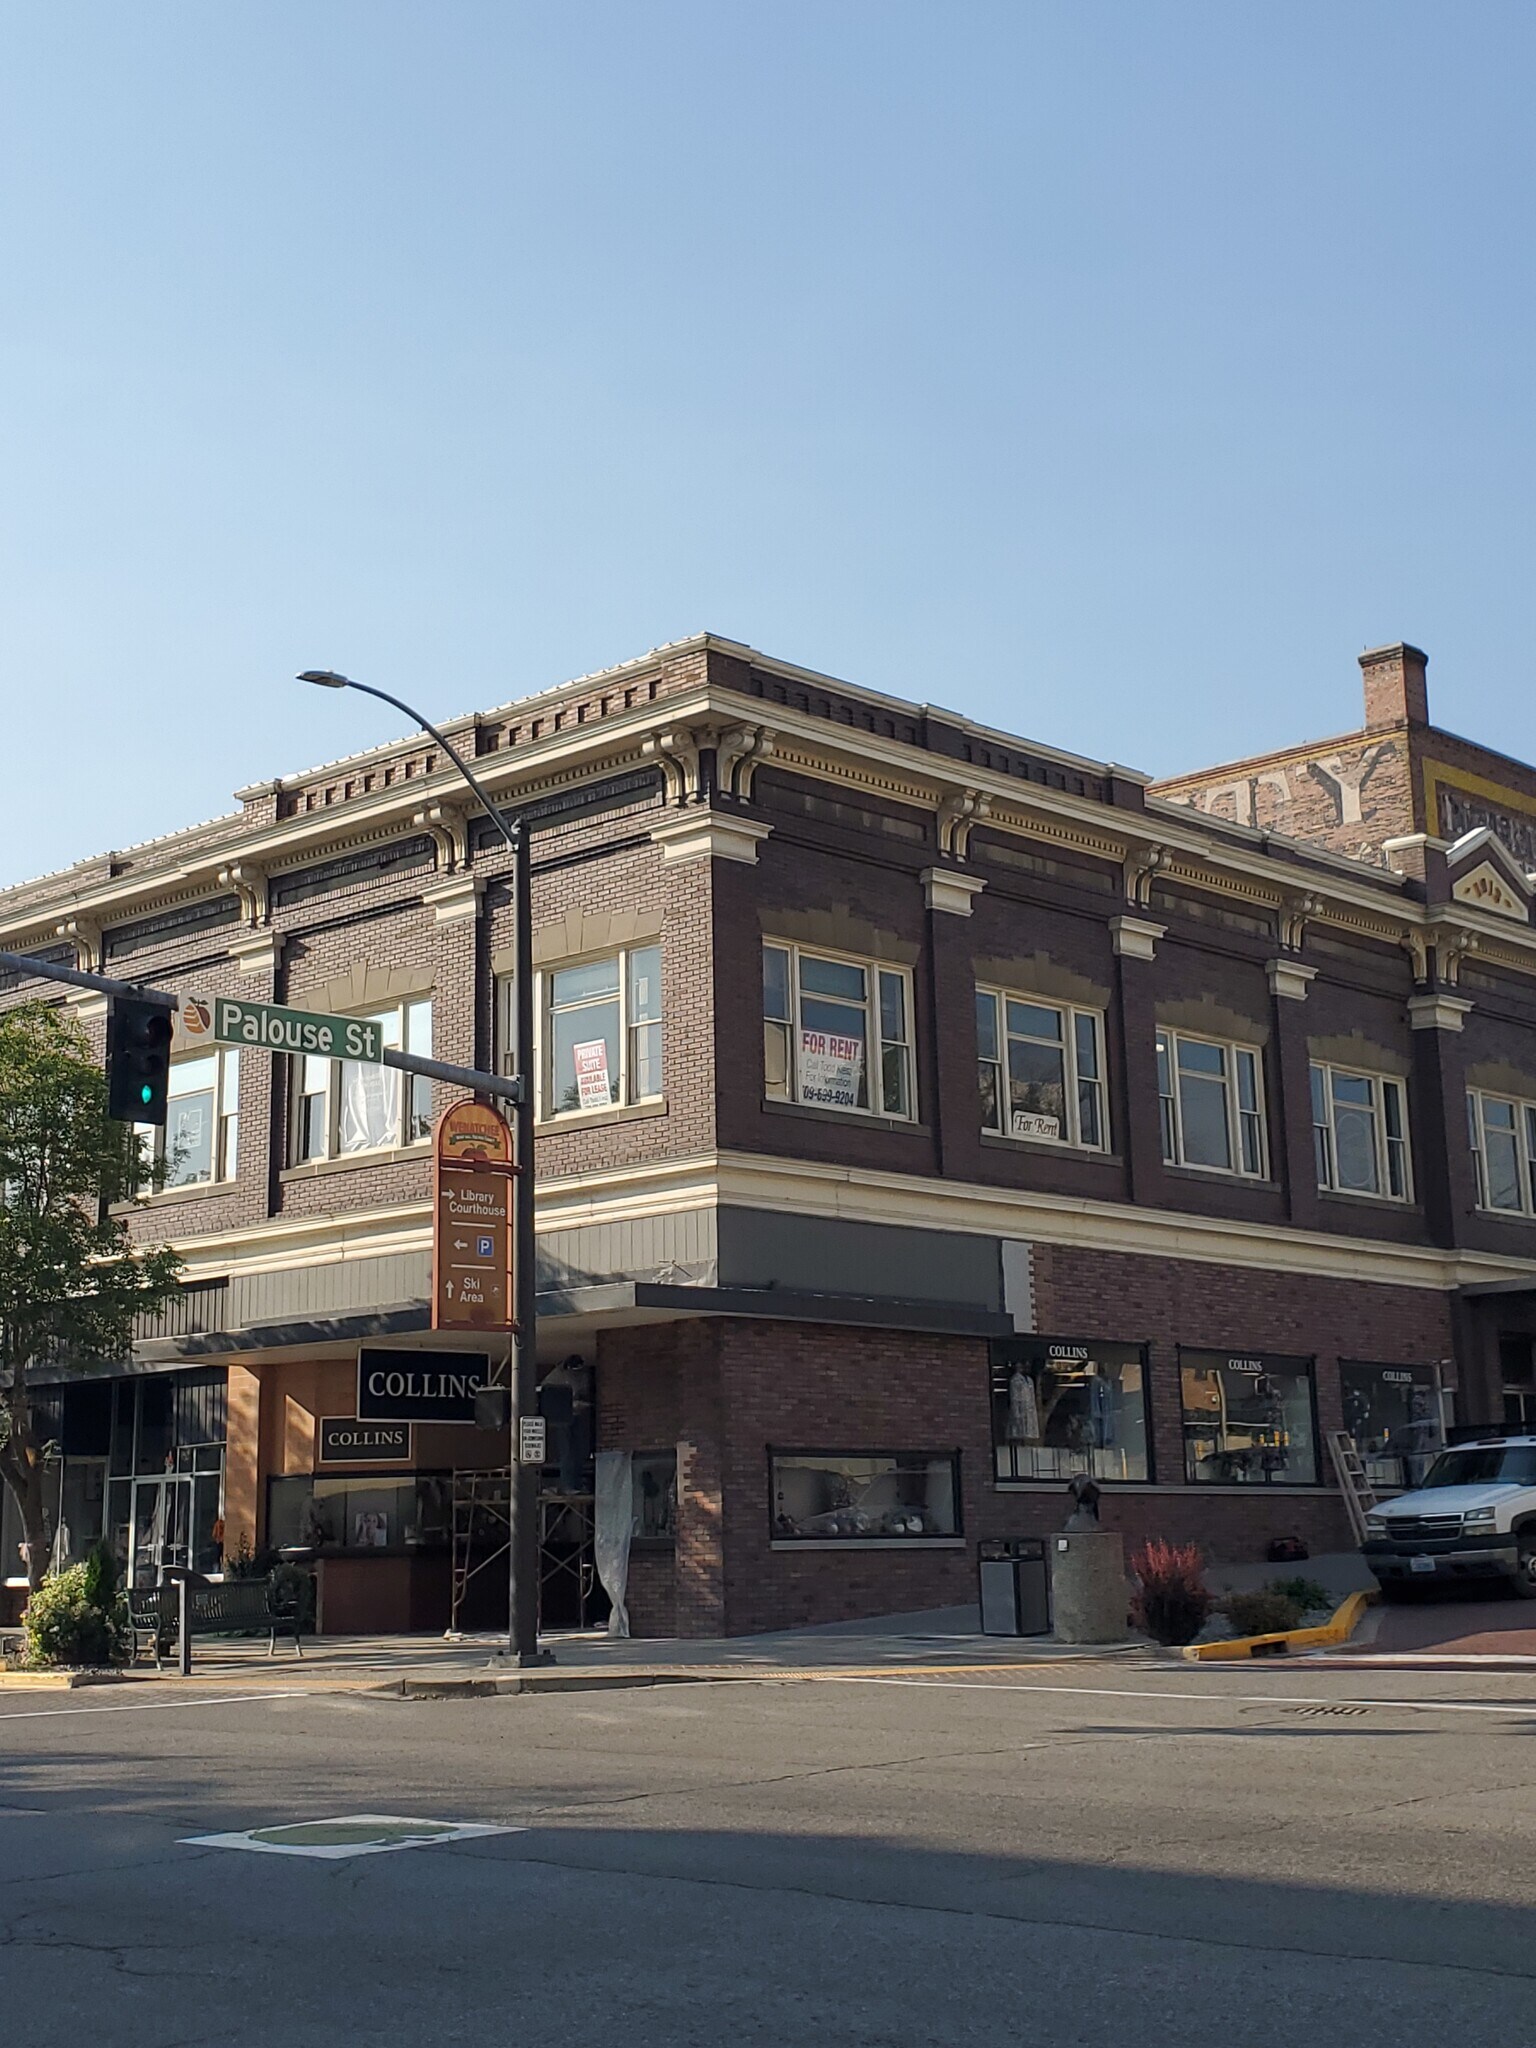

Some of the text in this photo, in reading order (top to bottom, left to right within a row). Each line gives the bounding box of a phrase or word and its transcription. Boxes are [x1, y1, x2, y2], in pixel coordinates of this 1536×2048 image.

[222, 1003, 375, 1059] Palouse St
[577, 1044, 603, 1060] PRIVATE
[802, 1032, 859, 1061] FOR RENT
[582, 1058, 601, 1072] SUITE
[805, 1070, 816, 1082] For
[581, 1083, 608, 1097] FOR LEASE
[449, 1120, 500, 1136] WENATCHEE
[1015, 1114, 1058, 1136] For Rent
[461, 1189, 494, 1204] Library
[449, 1201, 506, 1216] Courthouse
[480, 1240, 490, 1253] P
[463, 1277, 480, 1289] Ski
[460, 1290, 484, 1302] Area
[1049, 1345, 1088, 1358] COLLINS
[1228, 1359, 1263, 1372] COLLINS
[1382, 1371, 1413, 1382] COLLINS
[368, 1371, 480, 1399] COLLINS
[328, 1431, 403, 1446] COLLINS
